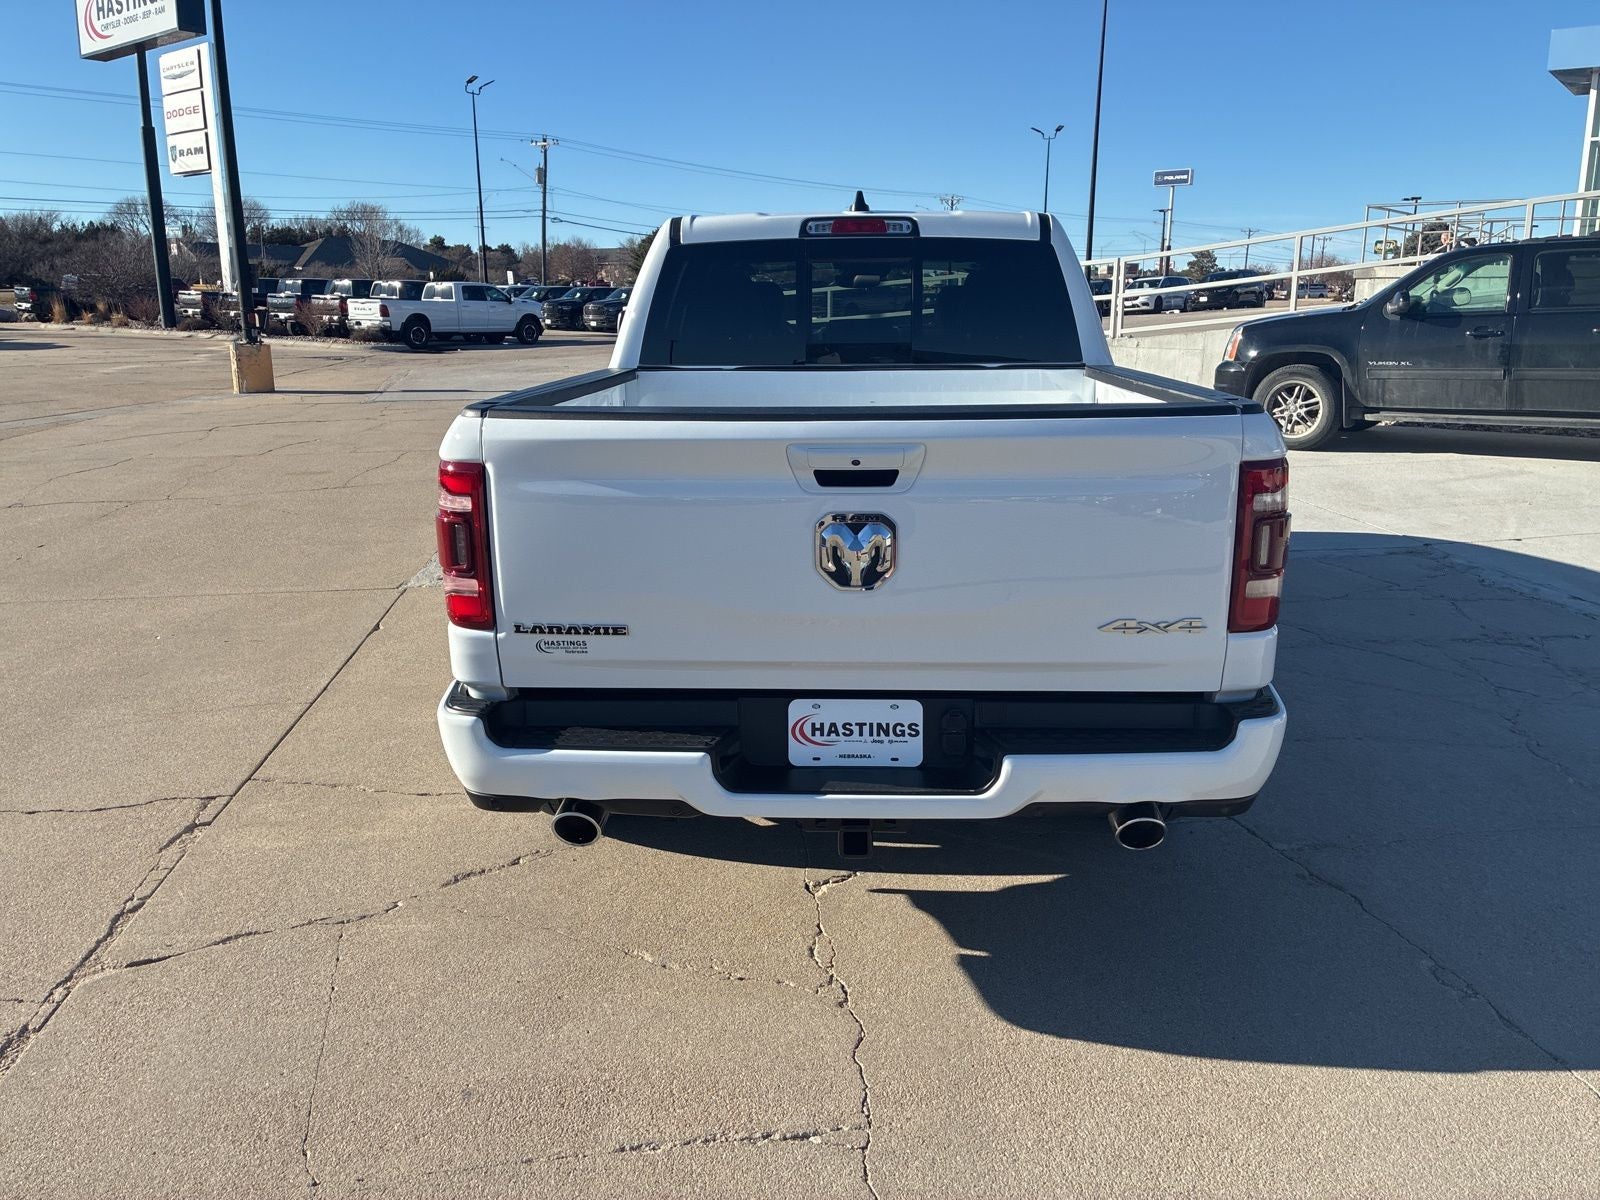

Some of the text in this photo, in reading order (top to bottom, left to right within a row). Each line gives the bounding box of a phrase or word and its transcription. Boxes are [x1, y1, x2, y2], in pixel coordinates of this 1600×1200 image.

[96, 0, 165, 21] HAST
[100, 5, 165, 32] CHRYSLER DODGE JEEP RAM
[162, 60, 195, 73] CHRYSLER
[166, 105, 201, 120] DODGE
[178, 145, 204, 158] RAM
[831, 513, 881, 523] RAM
[512, 622, 630, 636] LARAMIE
[810, 722, 920, 738] HASTINGS
